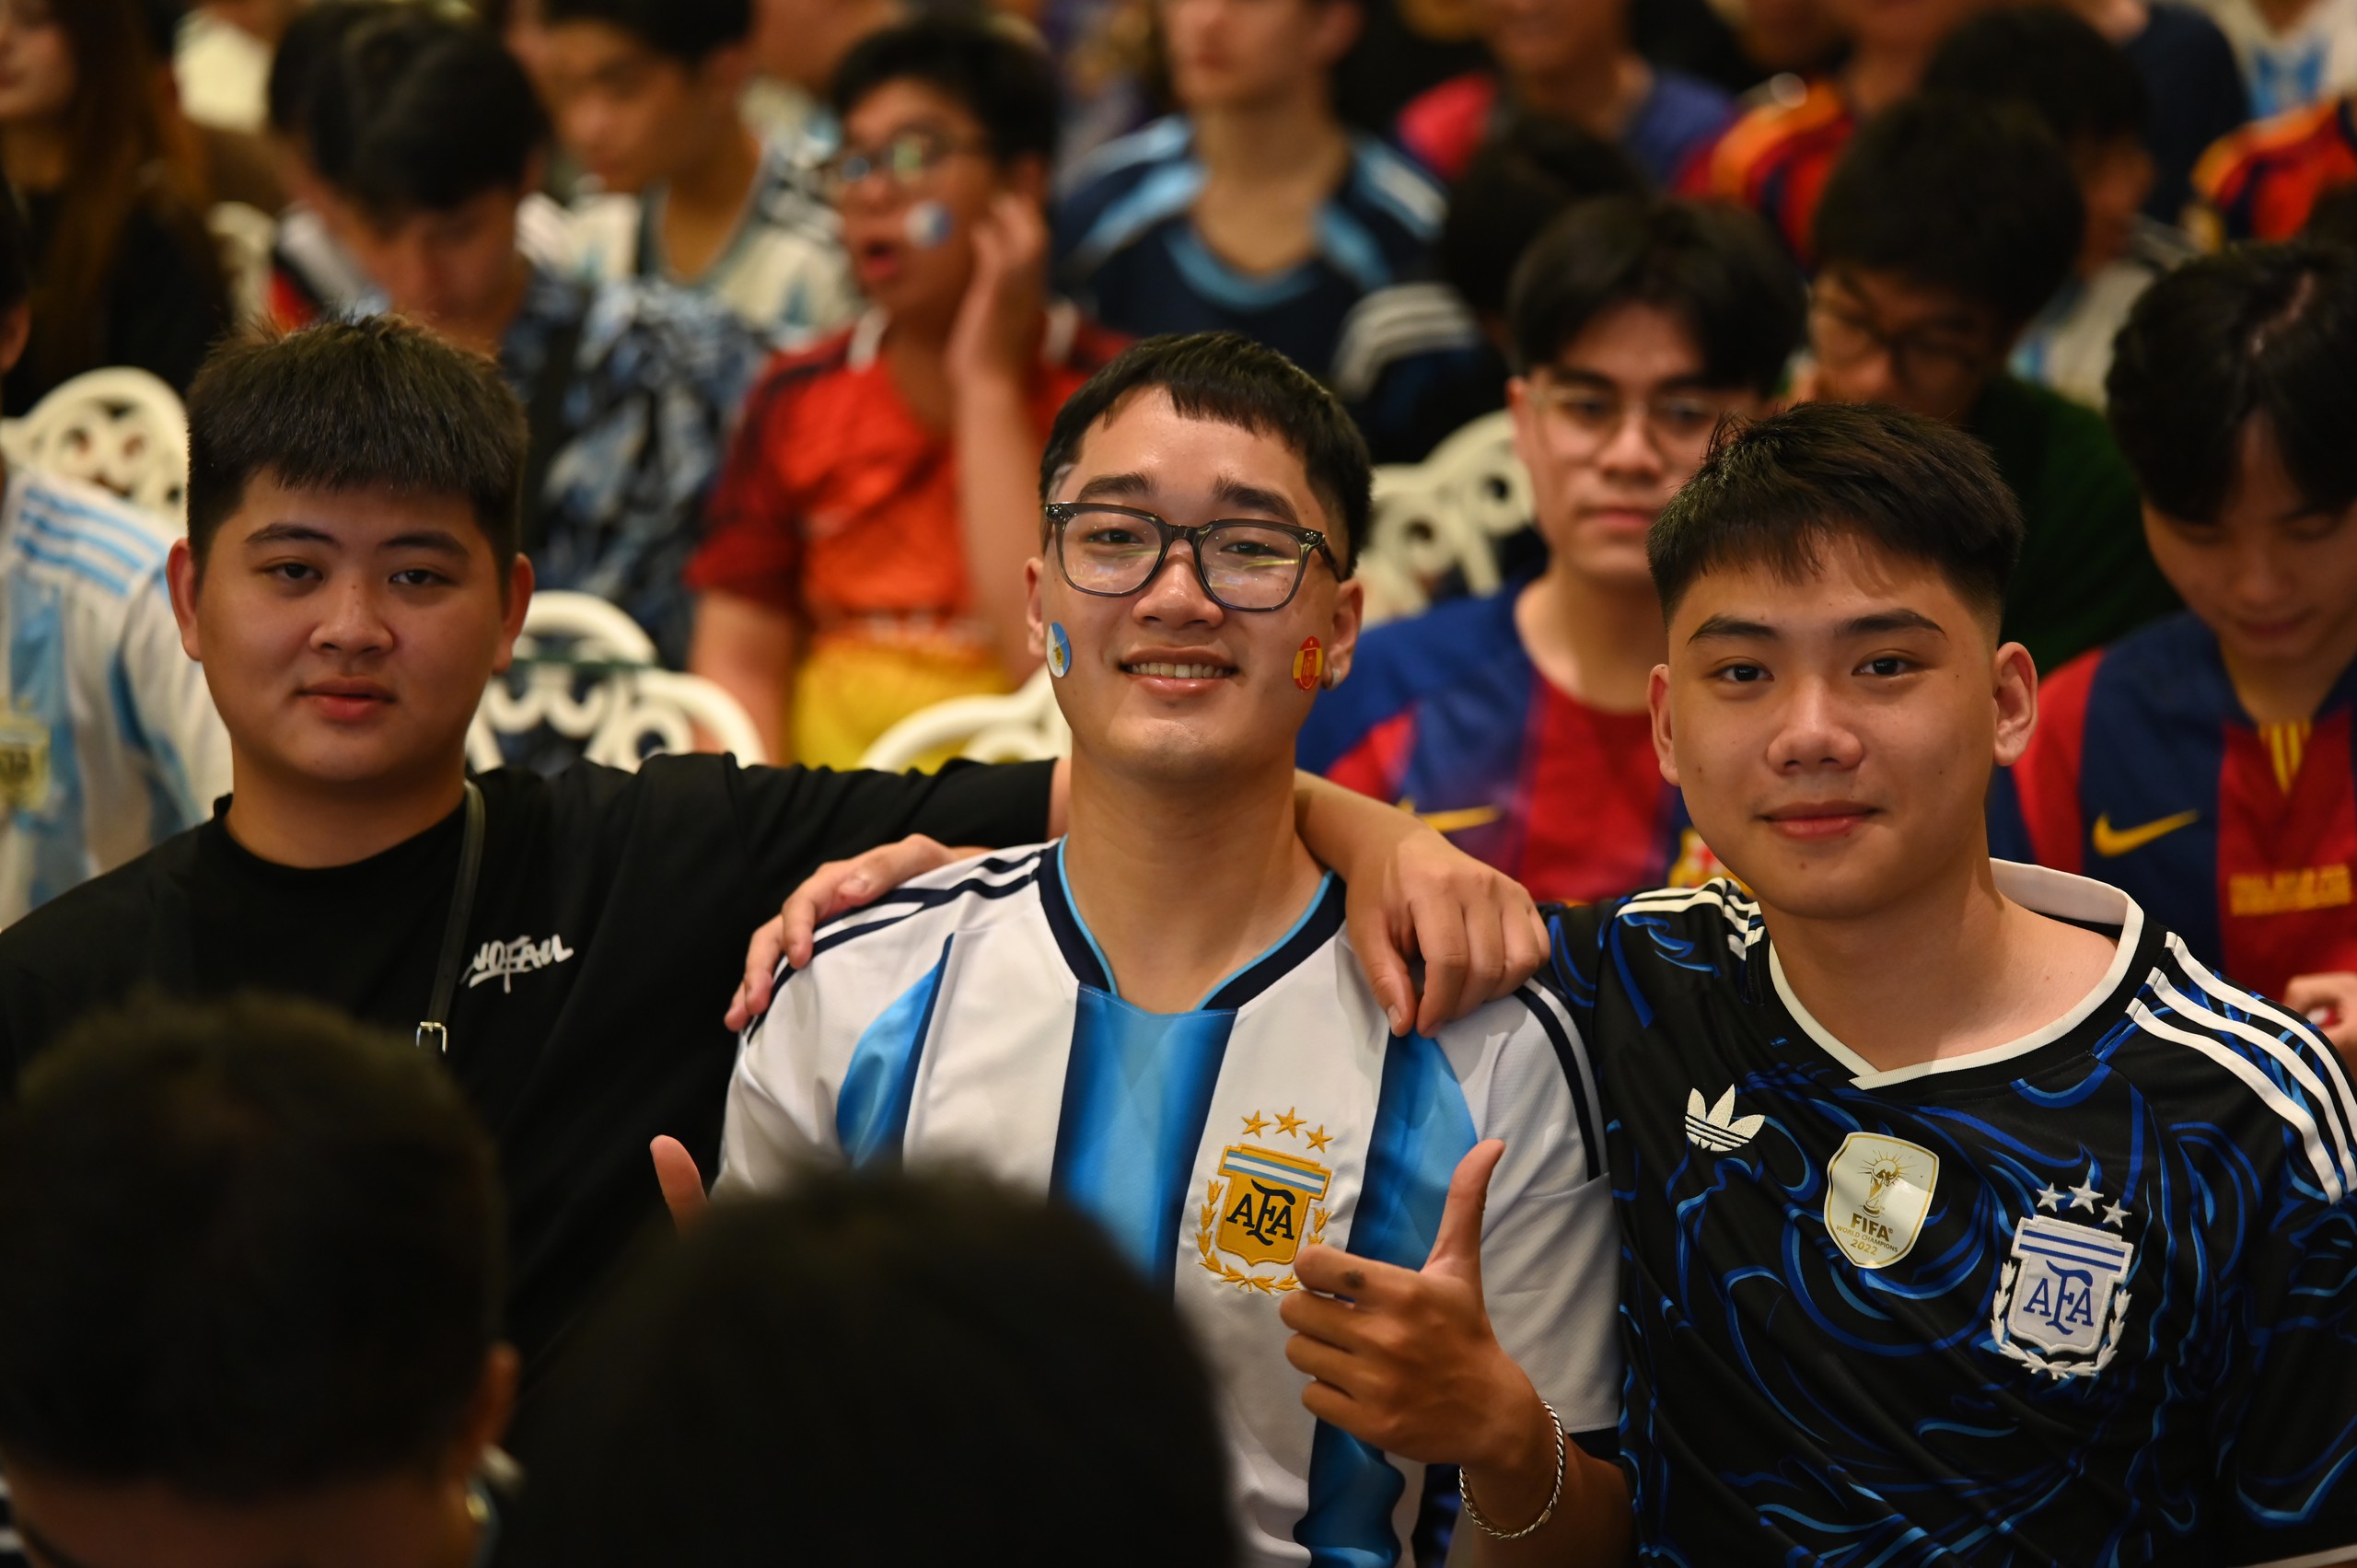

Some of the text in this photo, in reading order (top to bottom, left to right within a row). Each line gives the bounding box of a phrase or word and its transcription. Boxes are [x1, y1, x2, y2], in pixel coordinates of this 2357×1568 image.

[1225, 1179, 1296, 1246] AFA
[1836, 1225, 1898, 1253] WORLD CHAMPIONS
[1850, 1238, 1878, 1256] 2022
[2023, 1260, 2095, 1335] AFA
